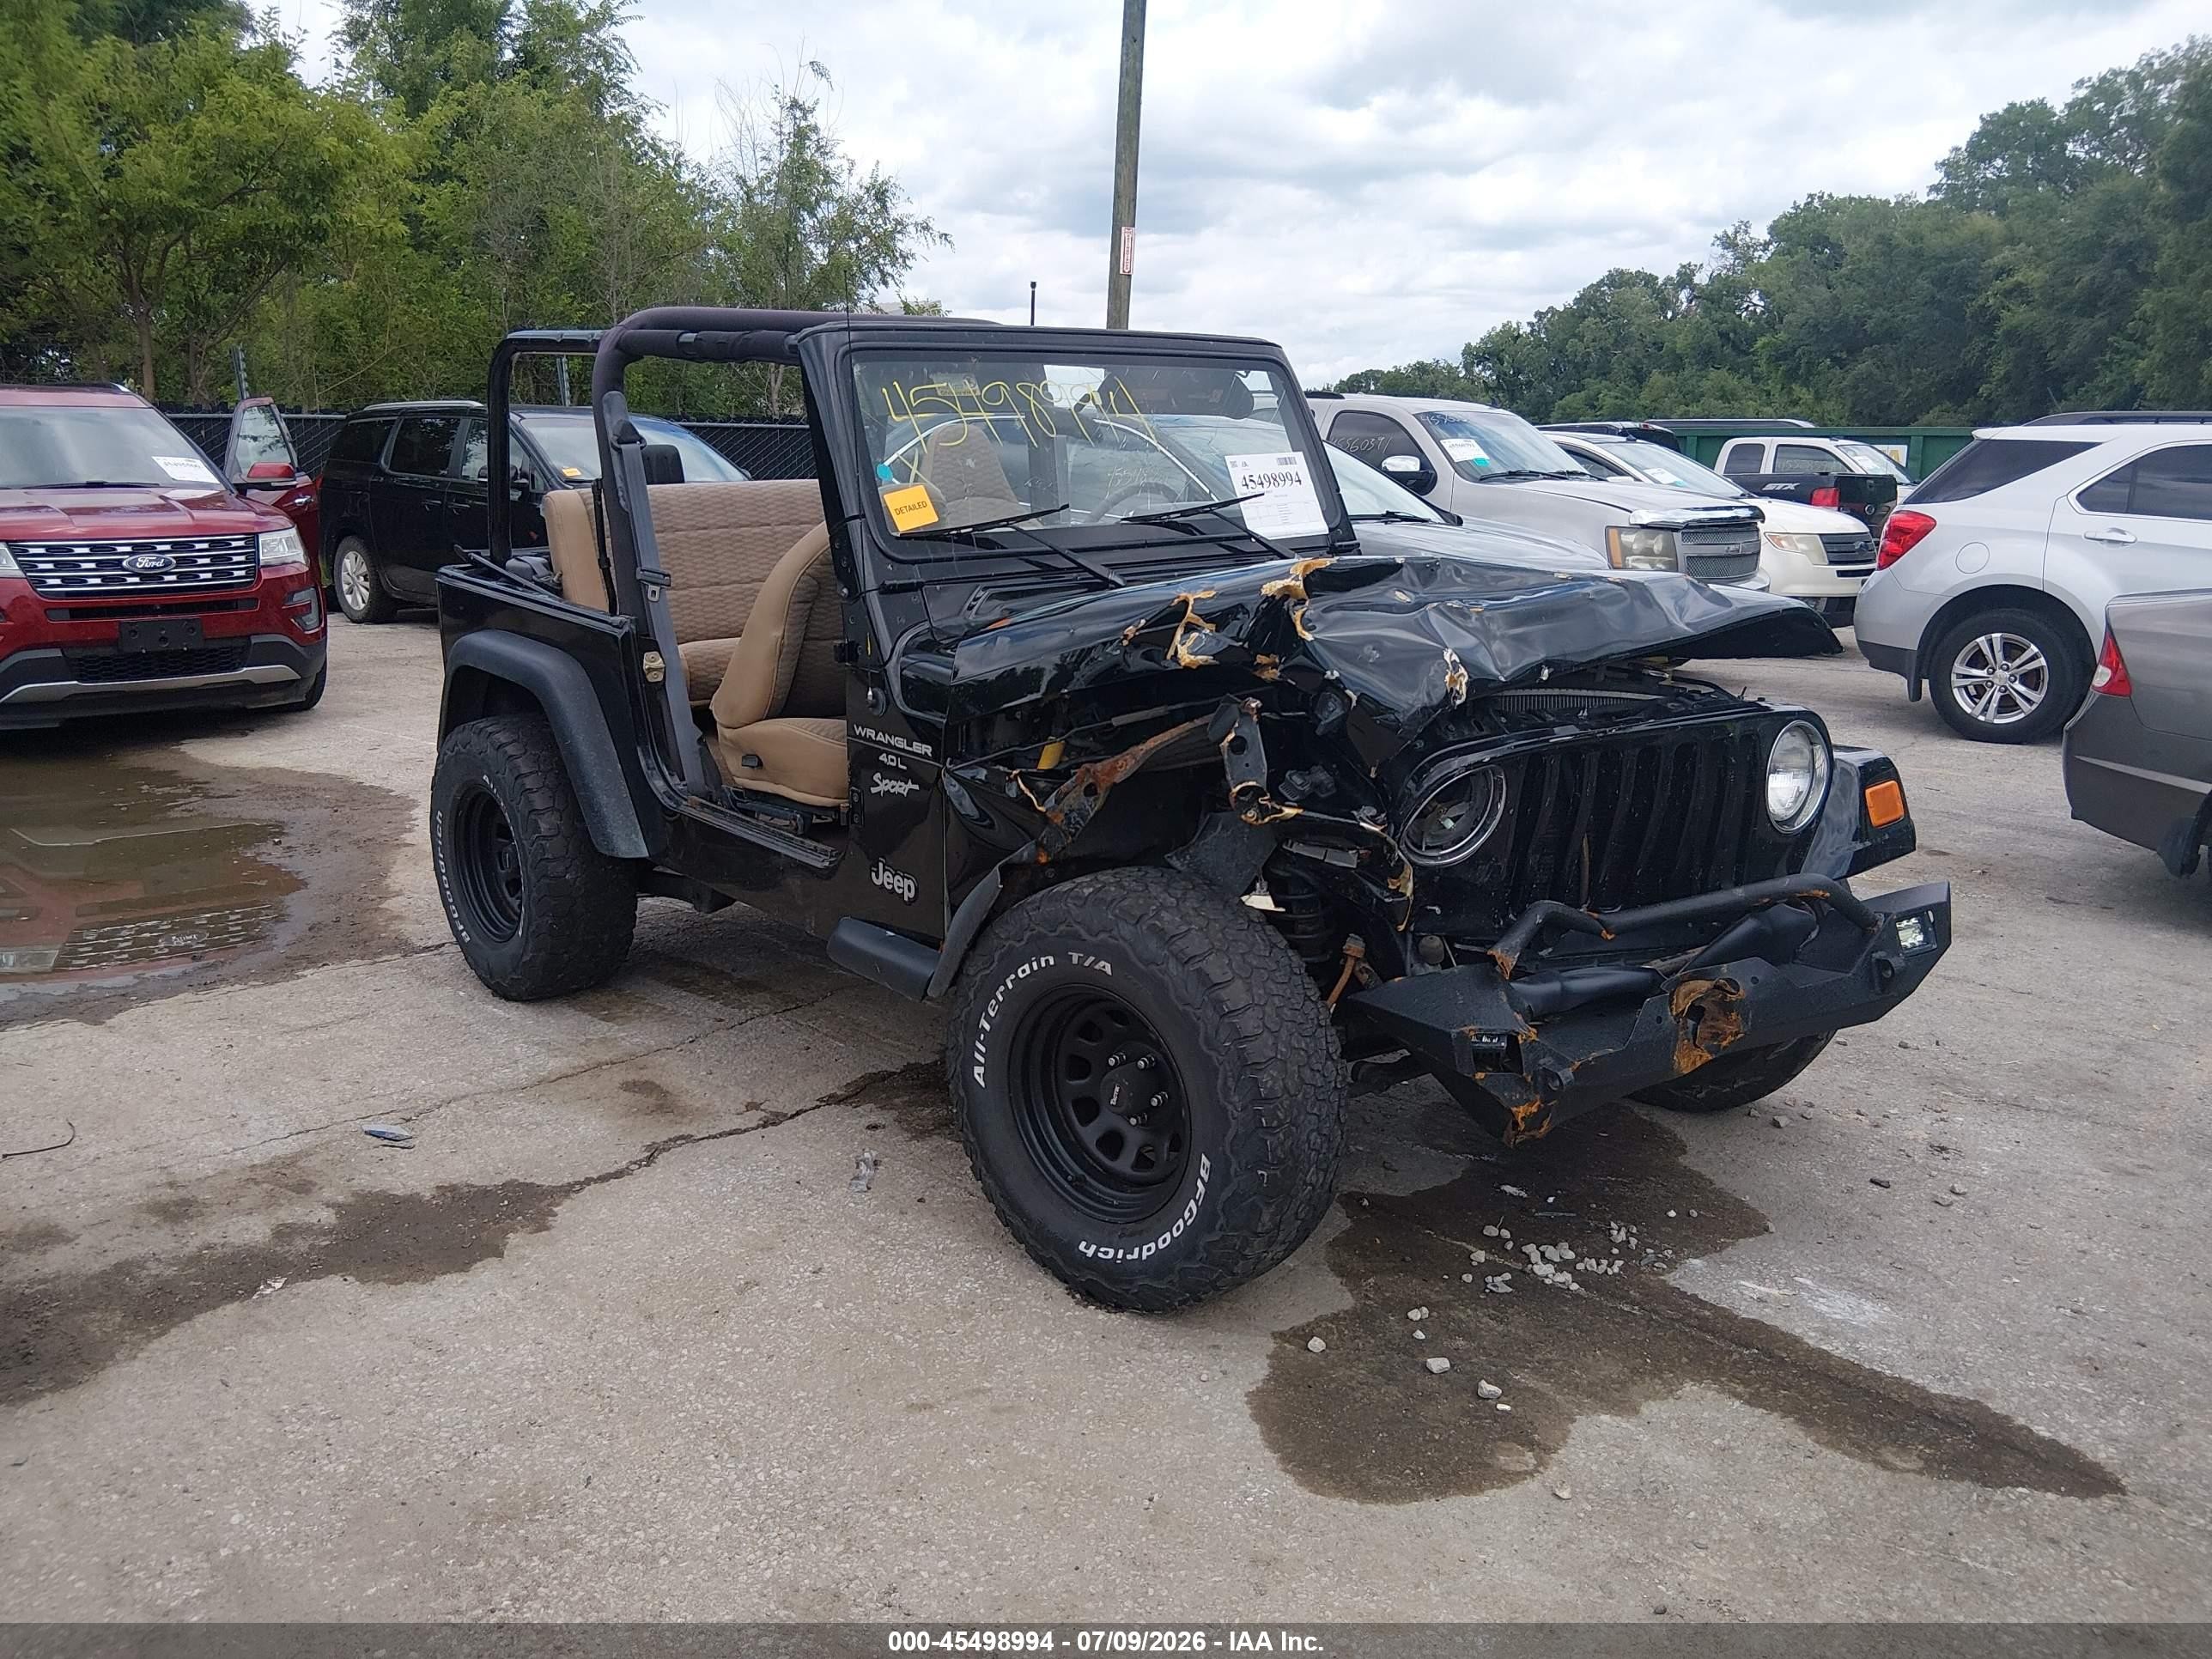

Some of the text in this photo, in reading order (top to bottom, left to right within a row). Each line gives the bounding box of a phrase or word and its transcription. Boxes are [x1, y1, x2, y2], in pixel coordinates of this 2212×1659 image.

[882, 375, 1160, 453] 45498994
[1241, 471, 1302, 490] 45498994
[1761, 483, 1800, 491] STX
[894, 501, 927, 516] DETAILED
[137, 556, 165, 568] Ford
[854, 724, 933, 757] WRANGLER
[870, 772, 920, 797] Sport
[435, 810, 471, 944] BFGoodrich
[871, 859, 917, 902] Jeep
[973, 951, 1114, 1089] All-Terrain T/A
[1078, 1152, 1212, 1264] BFGoodrich
